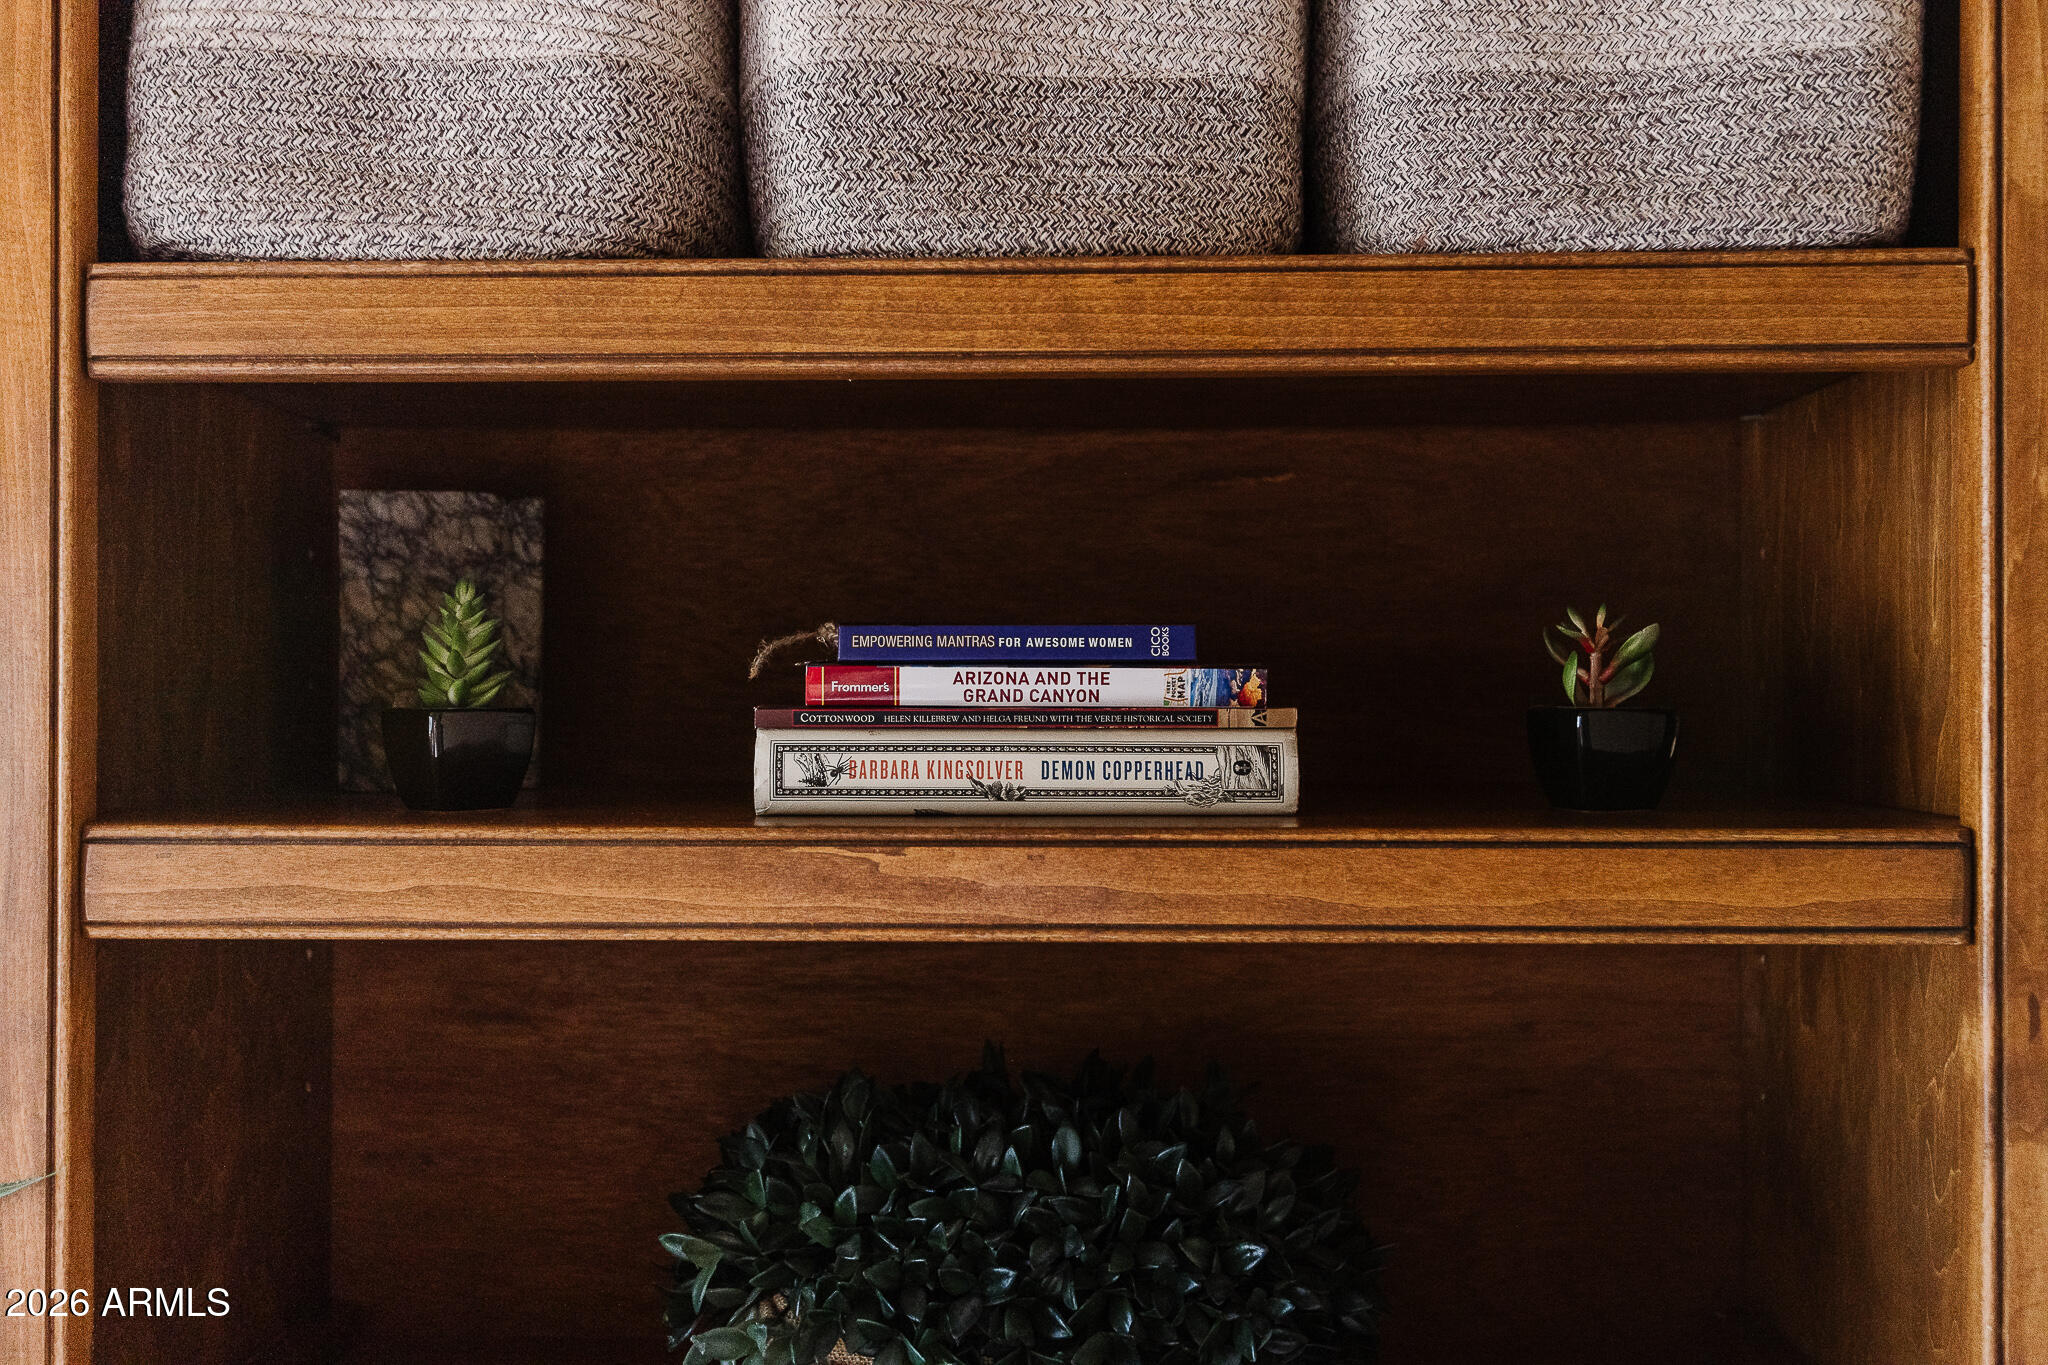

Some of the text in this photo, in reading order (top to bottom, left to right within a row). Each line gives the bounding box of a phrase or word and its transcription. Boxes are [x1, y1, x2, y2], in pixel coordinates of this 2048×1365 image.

[852, 635, 1133, 648] EMPOWERING MANTRAS FOR AWESOME WOMEN
[1150, 627, 1161, 657] CICO
[1161, 626, 1170, 657] BOOKS
[953, 671, 1111, 685] ARIZONA AND THE
[831, 681, 890, 693] Frommer's
[963, 688, 1100, 703] GRAND CANYON
[1177, 676, 1186, 699] MAP
[884, 715, 911, 723] HELEN
[913, 715, 960, 723] KILLEBREW
[961, 715, 982, 723] AND
[983, 715, 1012, 723] HELGA
[1013, 715, 1048, 723] FREUND
[1050, 715, 1073, 723] WITH
[1075, 715, 1093, 723] THE
[1094, 715, 1122, 723] VERDE
[1123, 715, 1175, 723] HISTORICAL
[1177, 715, 1213, 723] SOCIETY
[849, 760, 1024, 780] BARBARA KINGSOLVER
[1041, 760, 1204, 781] DEMON COPPERHEAD
